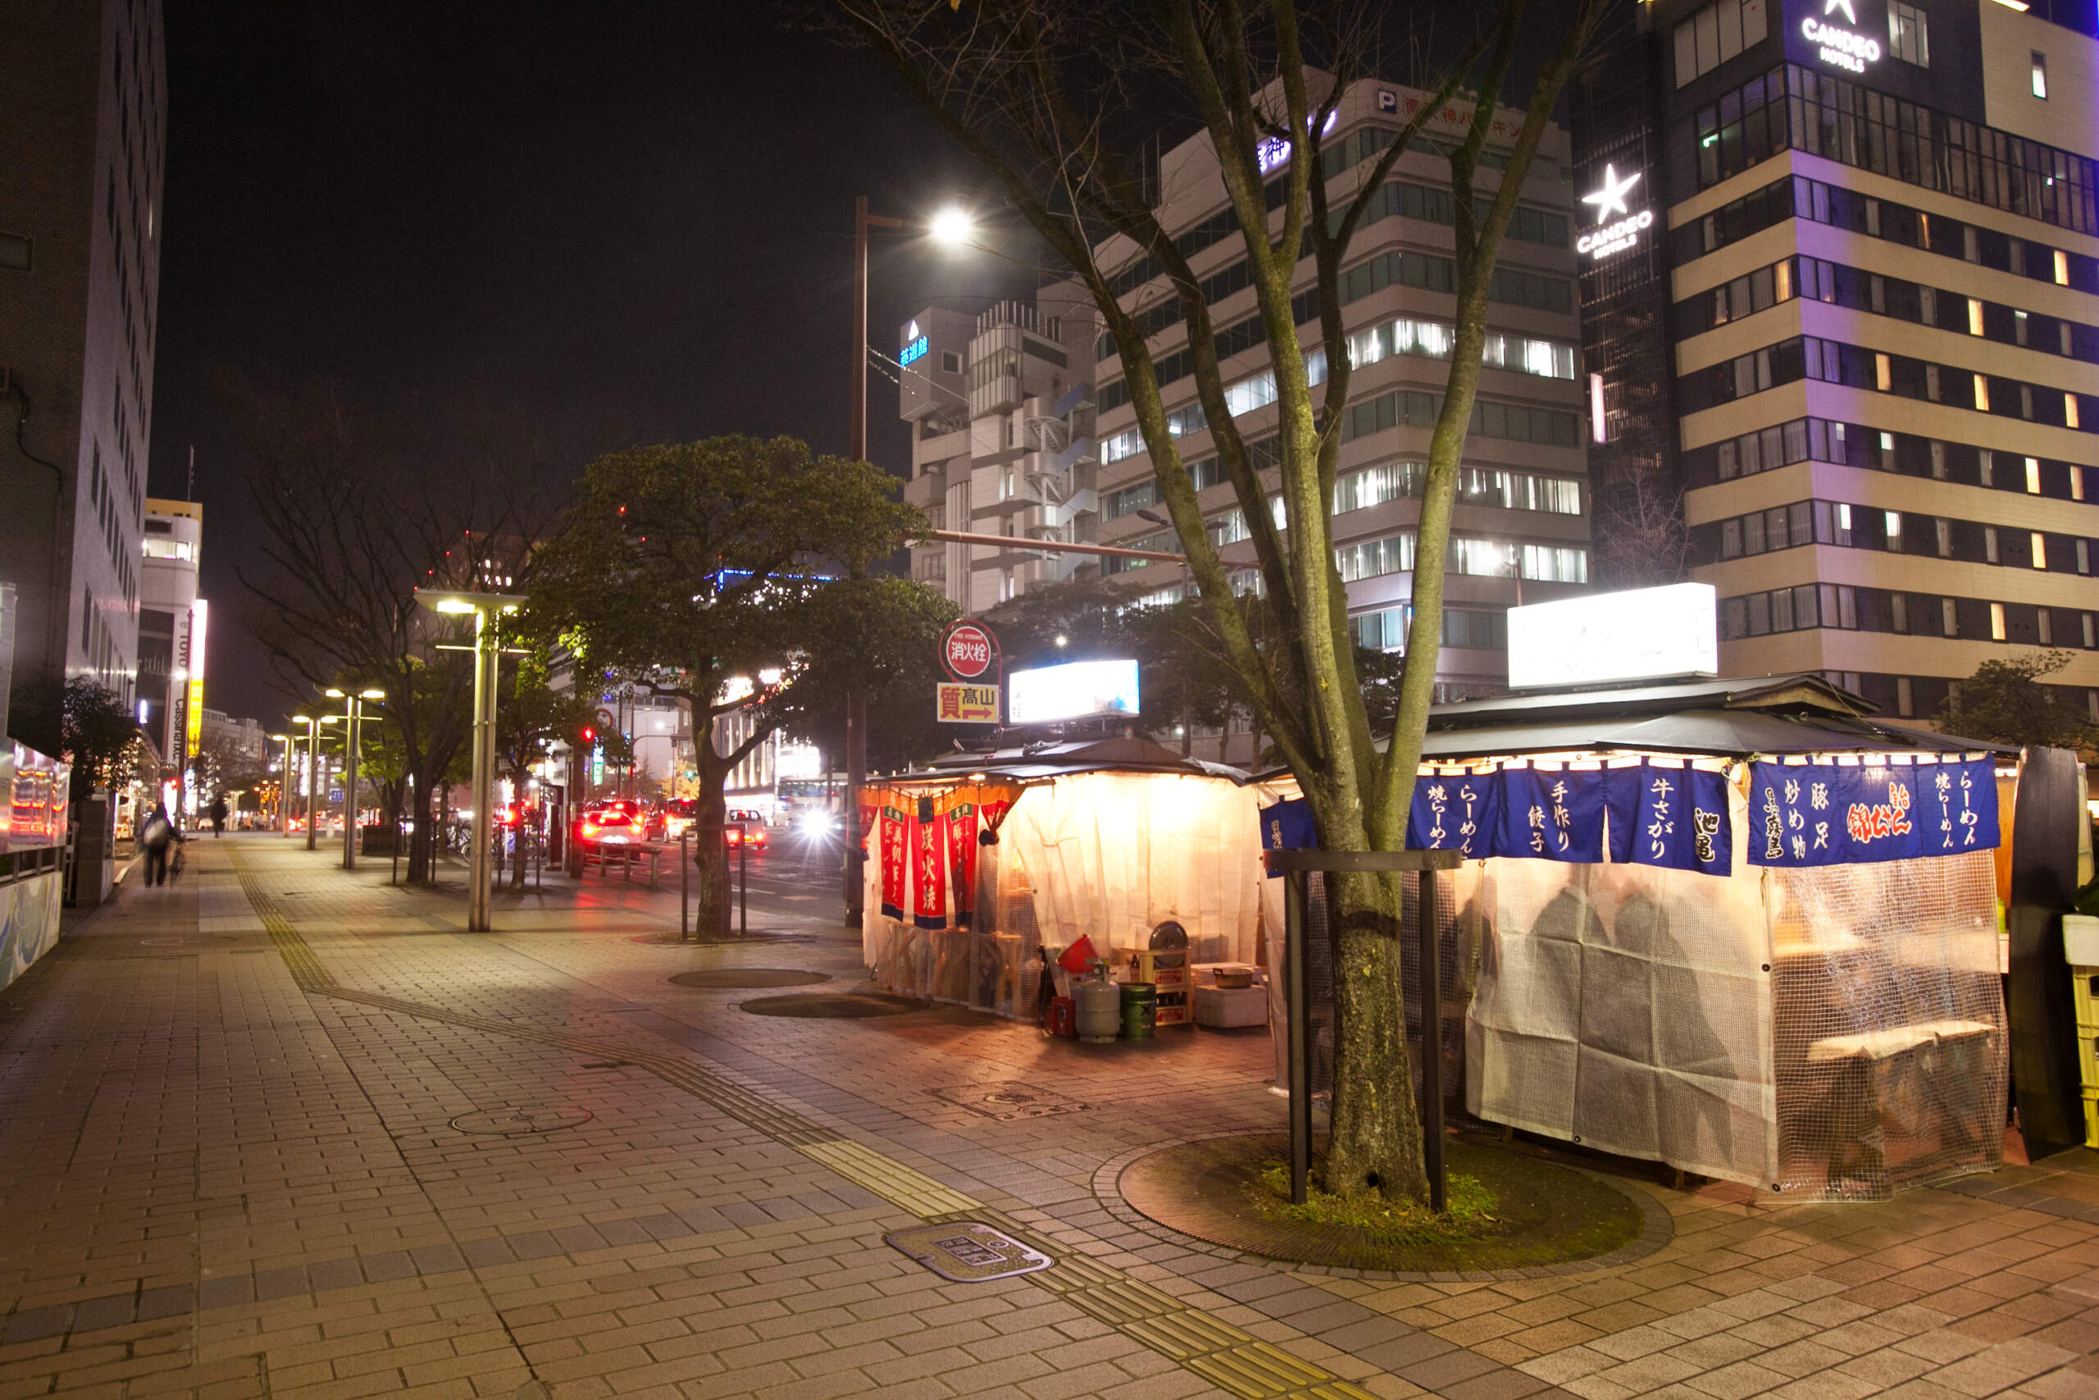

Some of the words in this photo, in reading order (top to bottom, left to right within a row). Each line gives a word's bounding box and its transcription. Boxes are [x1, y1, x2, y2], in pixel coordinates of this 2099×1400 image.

[1802, 18, 1880, 62] CANDEO
[1820, 46, 1865, 73] HOTELS
[1379, 91, 1395, 111] P
[1577, 210, 1653, 253] CANDEO
[1594, 233, 1637, 260] HOTELS
[951, 641, 987, 662] 消火栓
[940, 687, 961, 720] 質
[1459, 783, 1477, 854] らーめん
[1527, 804, 1546, 853] 餃子
[1551, 780, 1571, 853] 手作り
[1647, 777, 1675, 860] 牛さがり
[1784, 778, 1807, 860] 炒め物
[1811, 782, 1830, 850] 豚足
[1934, 771, 1954, 849] 焼らーめん
[1959, 770, 1979, 847] らーめん
[921, 823, 937, 912] 炭火焼
